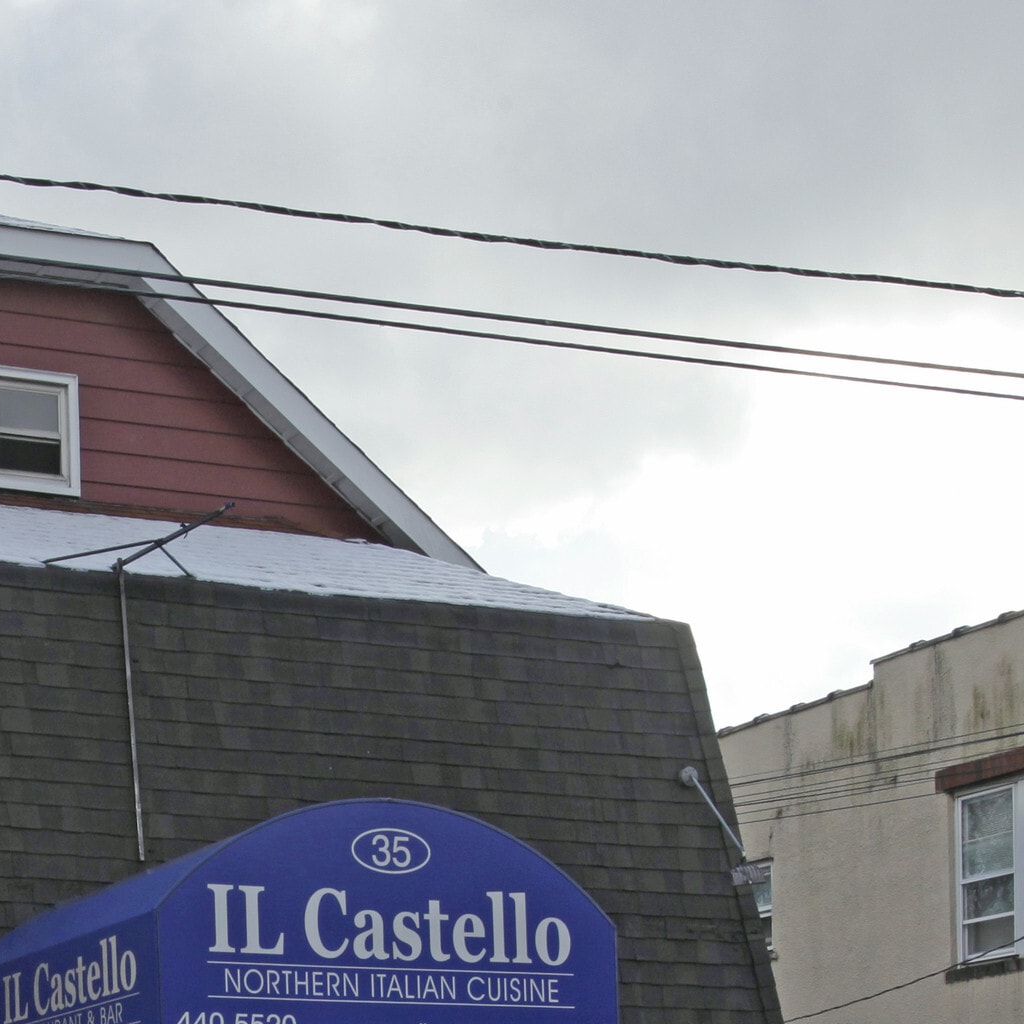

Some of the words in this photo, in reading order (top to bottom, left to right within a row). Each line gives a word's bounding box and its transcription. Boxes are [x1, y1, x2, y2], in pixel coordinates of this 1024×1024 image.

[371, 834, 411, 868] 35
[207, 883, 285, 955] IL
[304, 887, 571, 967] Castello
[2, 971, 29, 1024] IL
[33, 935, 137, 1016] Castello
[224, 968, 359, 998] NORTHERN
[370, 973, 456, 1000] ITALIAN
[467, 976, 559, 1003] CUISINE
